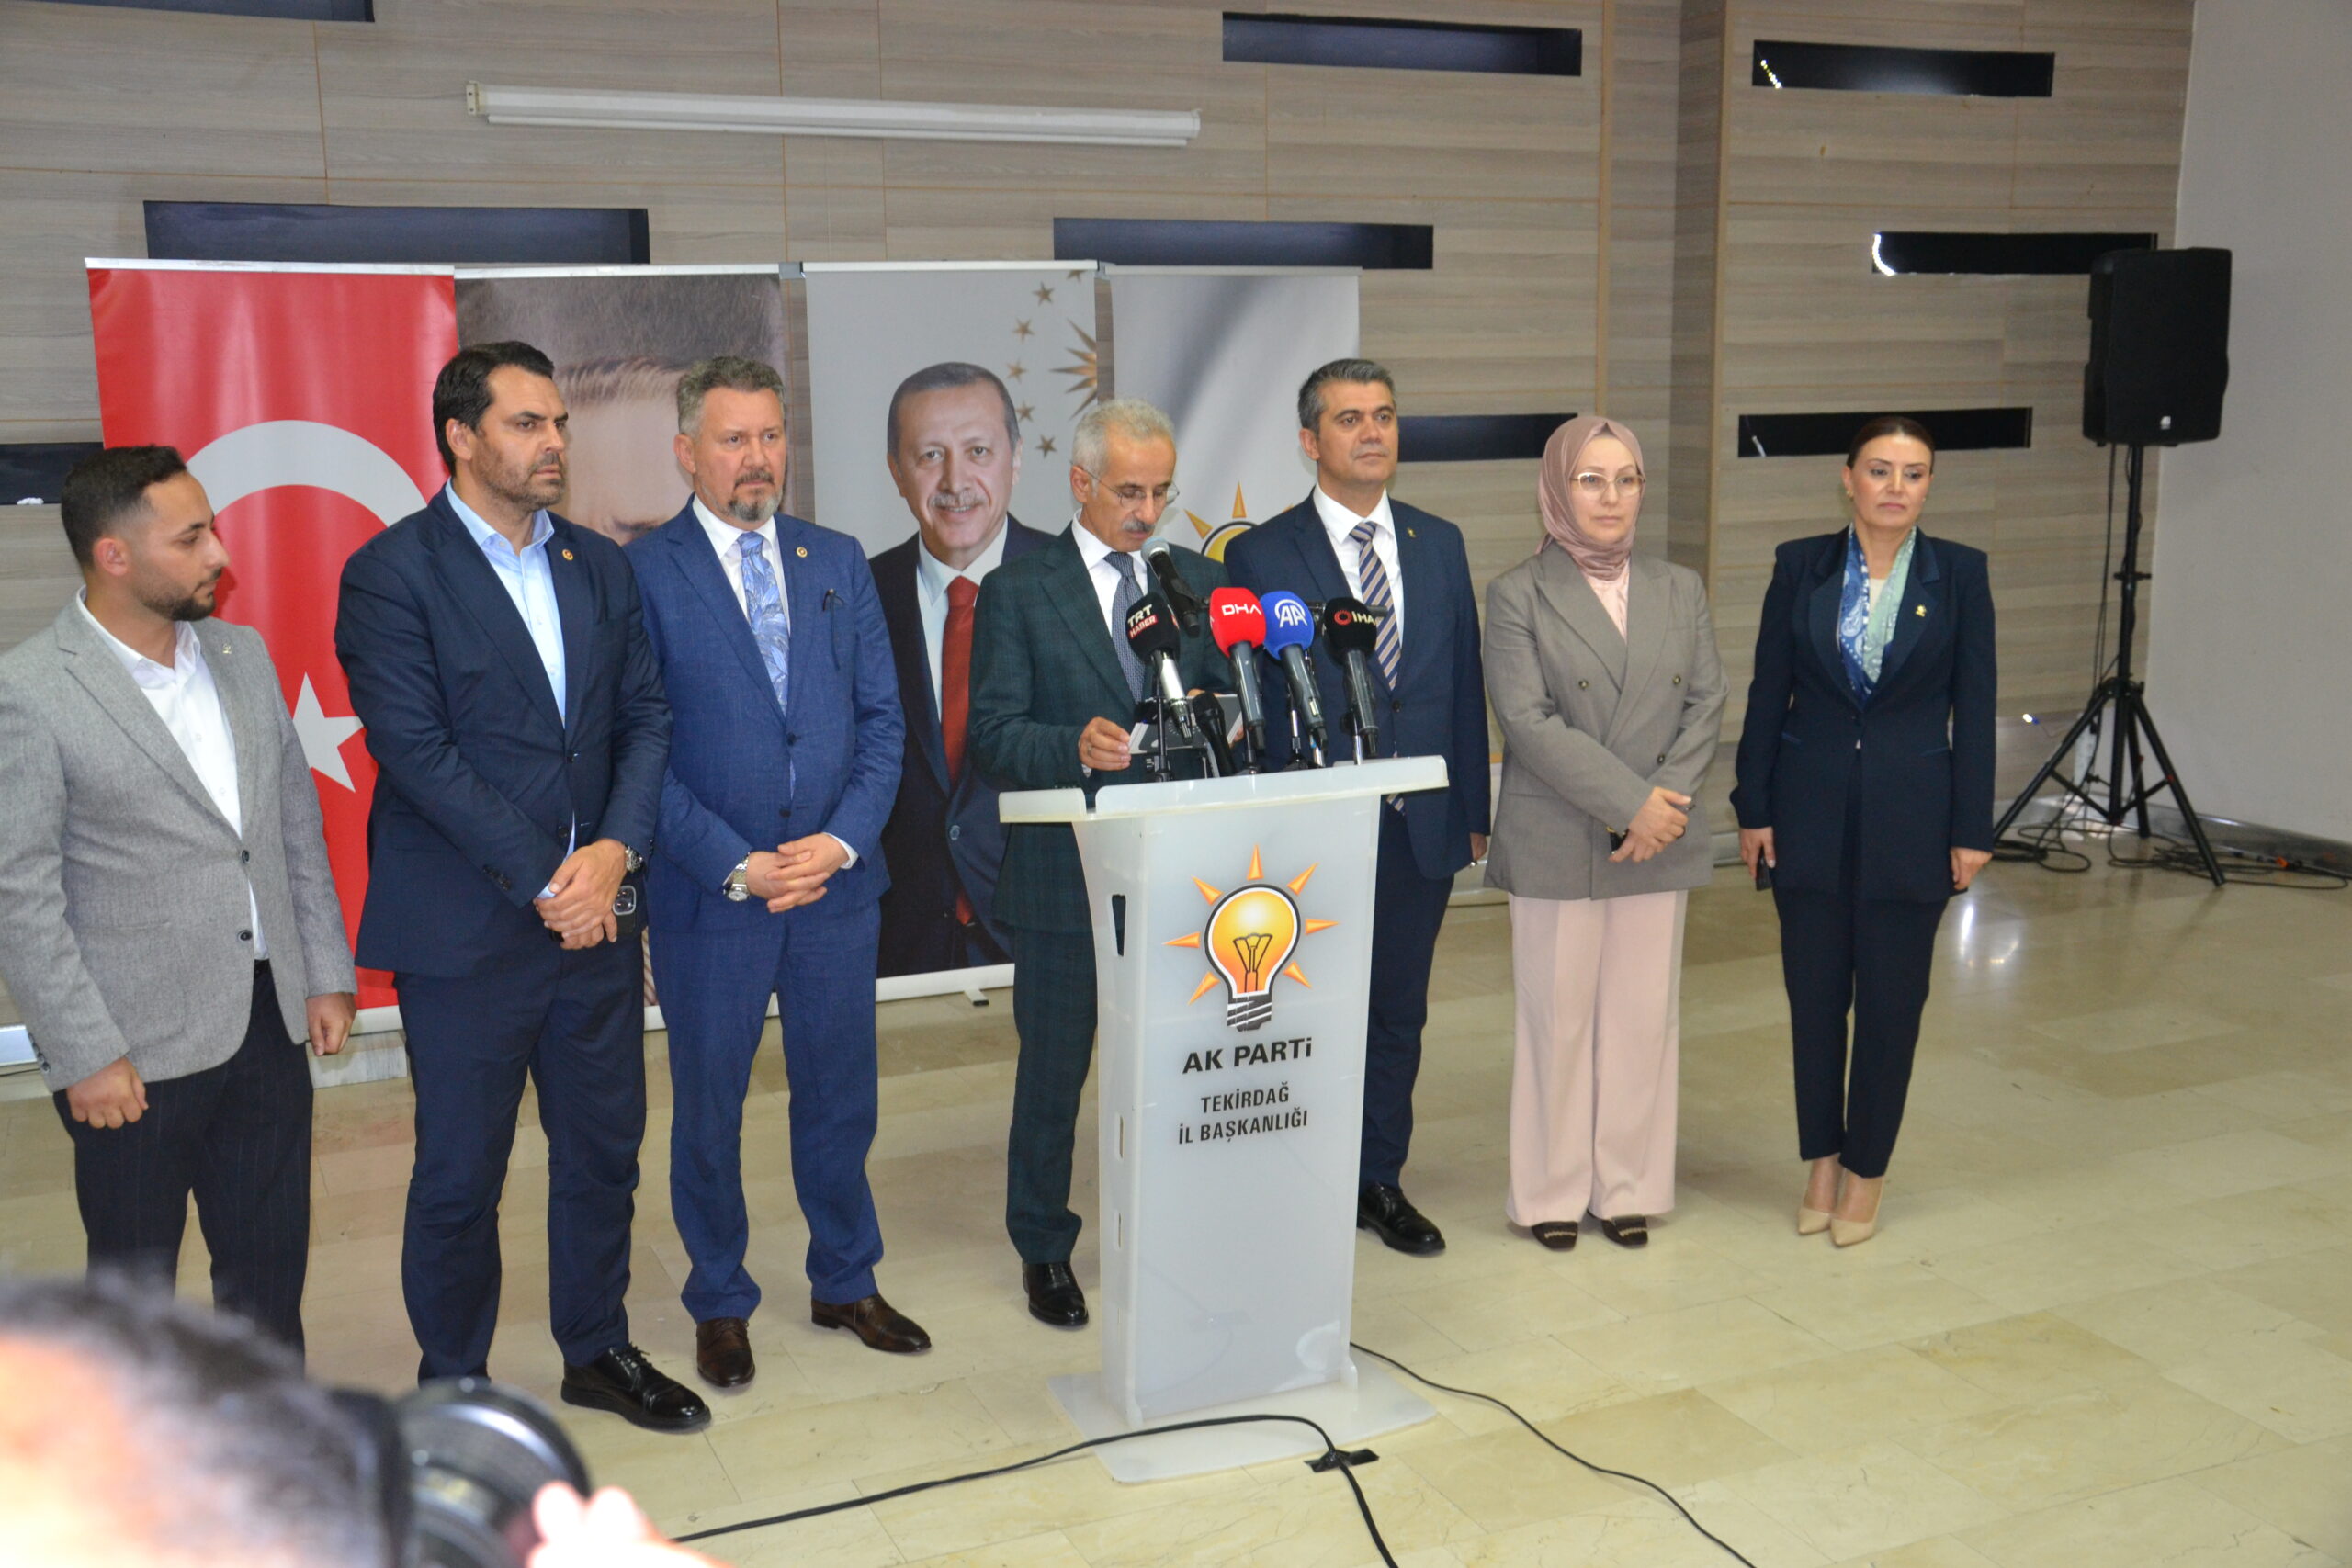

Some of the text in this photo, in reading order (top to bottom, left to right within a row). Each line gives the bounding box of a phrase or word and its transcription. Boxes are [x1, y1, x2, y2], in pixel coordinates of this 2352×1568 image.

[1127, 603, 1152, 628] TRT
[1221, 603, 1261, 616] DHA
[1279, 604, 1308, 628] AA
[1129, 615, 1158, 639] HABER
[1182, 1048, 1223, 1074] AK
[1201, 1081, 1289, 1114] TEKİRDAĞ
[1178, 1107, 1307, 1145] İL BAŞKANLIĞI
